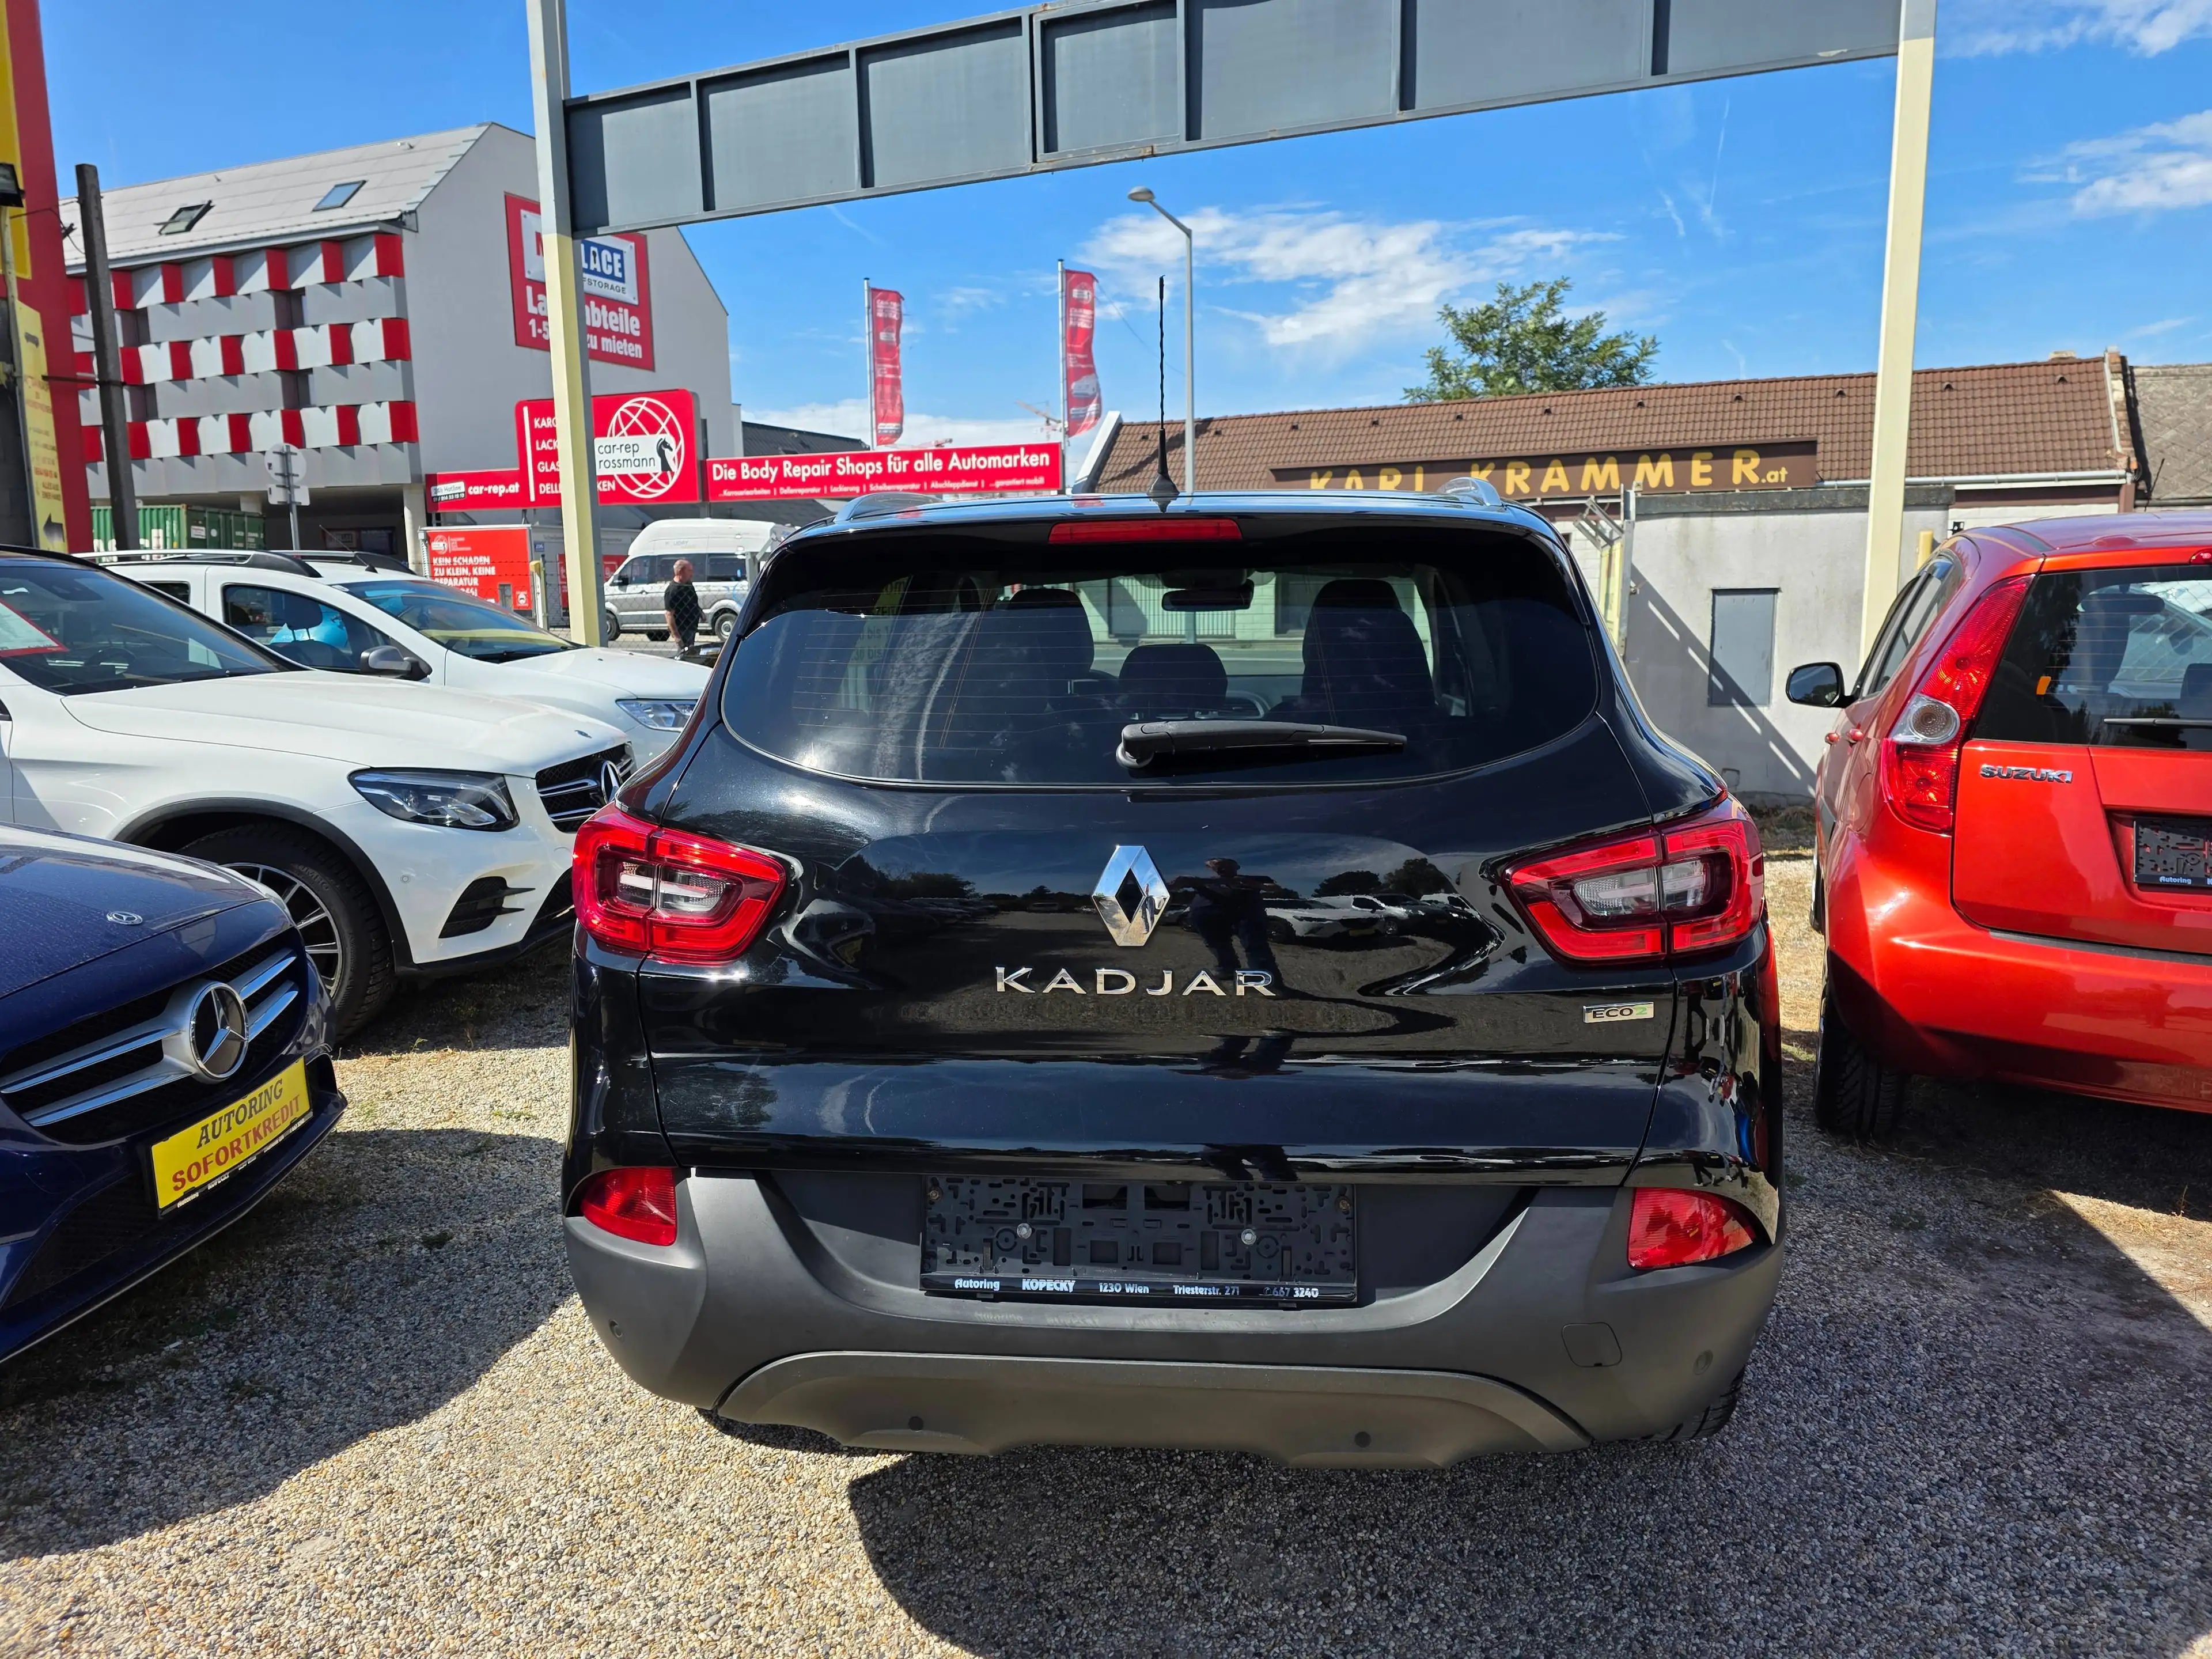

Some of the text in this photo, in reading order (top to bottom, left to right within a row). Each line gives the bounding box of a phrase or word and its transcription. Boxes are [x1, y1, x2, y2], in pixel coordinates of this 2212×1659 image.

[601, 335, 642, 358] mieten
[598, 444, 639, 457] car-rep
[599, 457, 656, 469] rossmann
[713, 448, 1050, 483] Die Body Repair Shops für alle Automarken
[468, 482, 520, 497] car-rep.at
[433, 555, 490, 566] KEIN SCHADEN
[434, 566, 496, 577] ZU KLEIN, KEINE
[1979, 764, 2073, 784] SUZUKI
[2159, 876, 2192, 885] Autoring
[995, 966, 1277, 996] KADJAR
[196, 1078, 283, 1149] AUTORING
[172, 1094, 300, 1192] SOFORTKREDIT
[955, 1278, 1001, 1291] Autoring
[1022, 1278, 1076, 1293] KOPECKY
[1099, 1282, 1122, 1294] 1230
[1125, 1283, 1150, 1294] Wien
[1173, 1285, 1222, 1296] Triesterstr.
